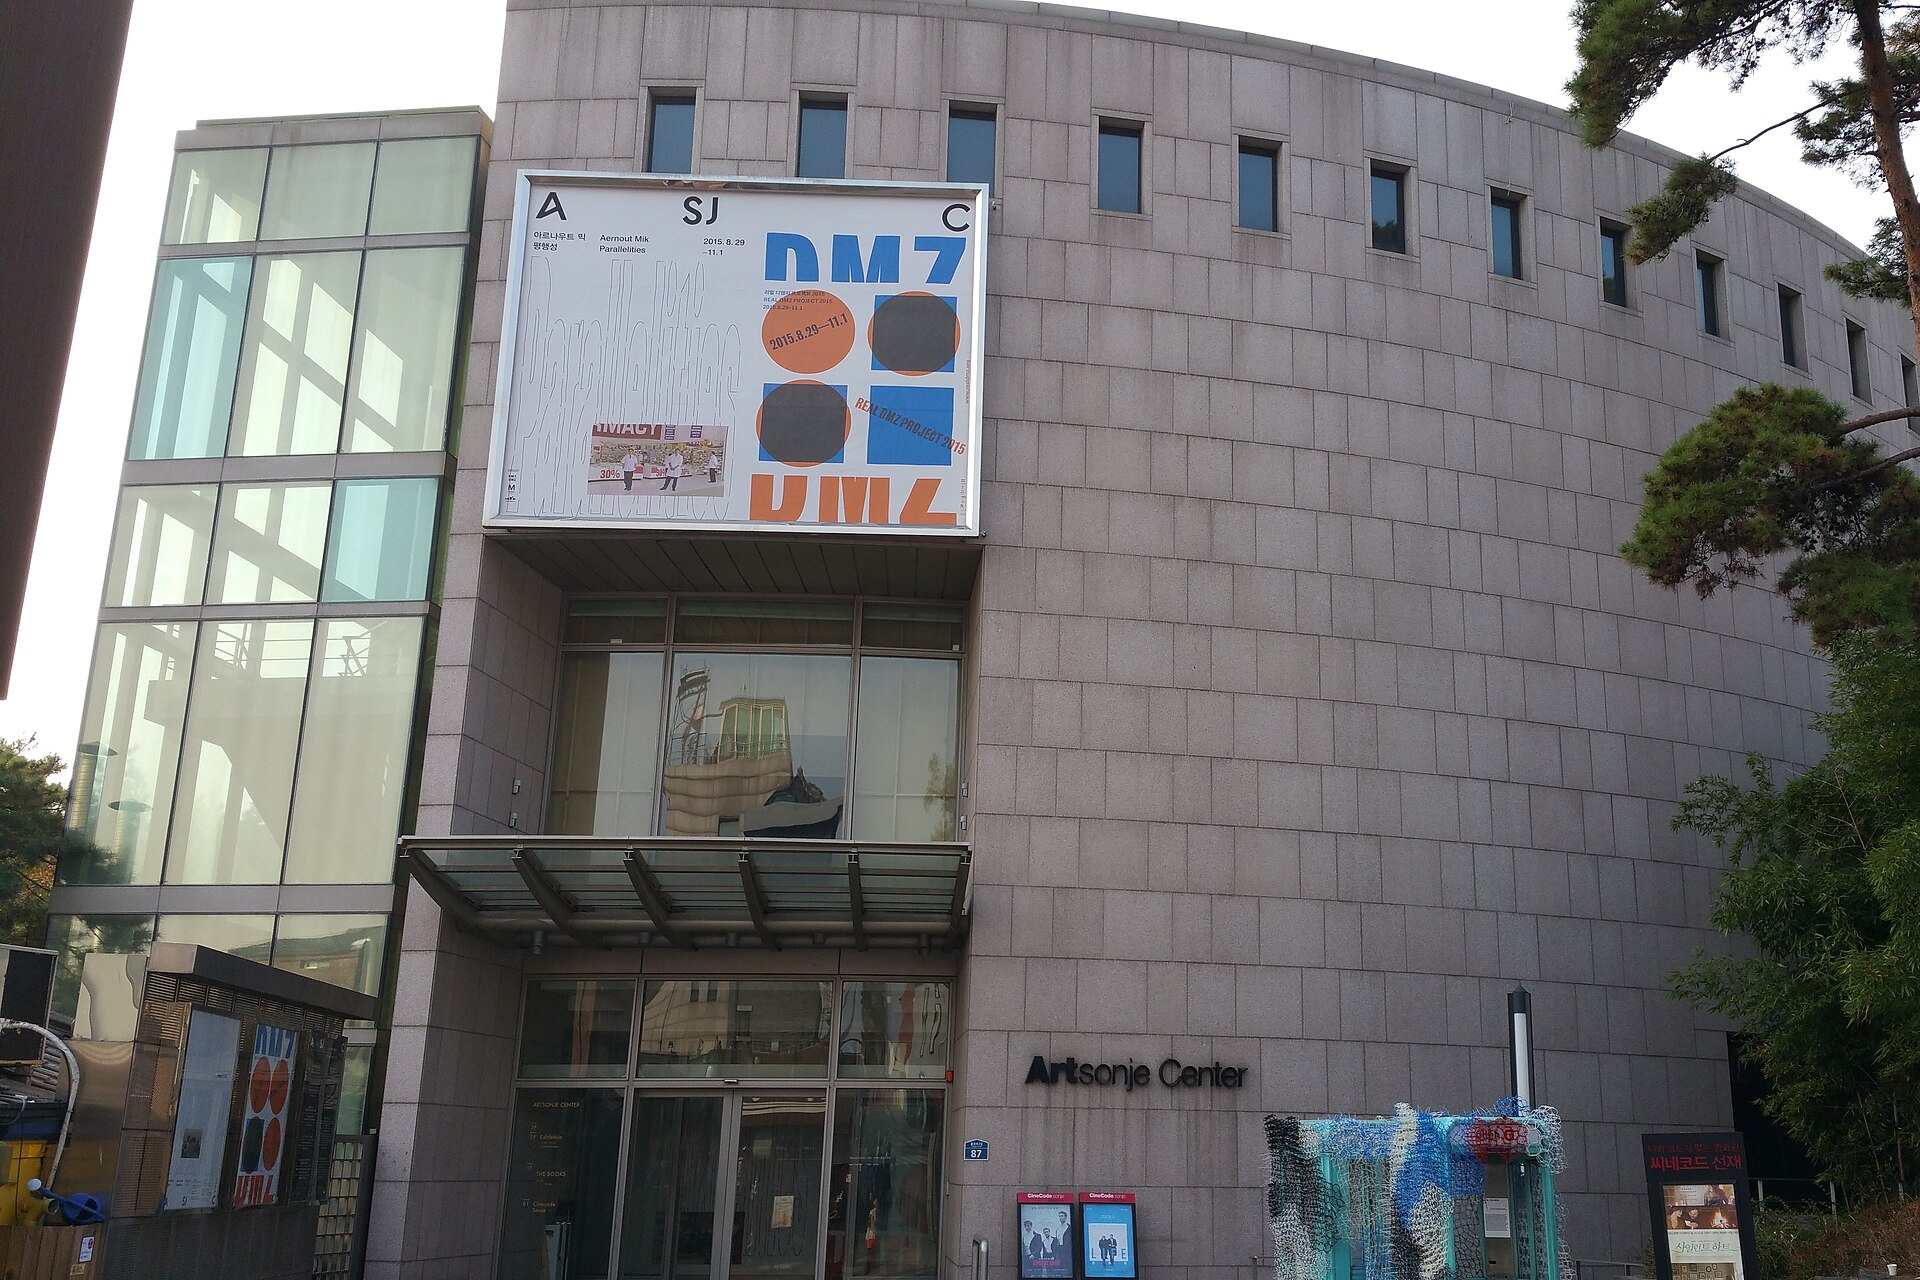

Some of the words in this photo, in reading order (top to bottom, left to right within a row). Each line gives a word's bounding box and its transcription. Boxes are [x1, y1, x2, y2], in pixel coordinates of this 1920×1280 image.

[535, 191, 568, 221] A
[941, 203, 971, 232] C
[533, 231, 575, 241] 아르나우트
[600, 234, 632, 244] Aernout
[634, 235, 650, 244] Mik
[533, 242, 558, 252] 평행성
[599, 245, 647, 254] Parallelities
[854, 397, 879, 417] REAL
[878, 407, 902, 426] DMZ
[900, 417, 943, 444] PROJECT
[941, 436, 967, 455] 2015
[600, 470, 620, 479] 30%
[1024, 1055, 1151, 1091] Artsonje
[1158, 1058, 1249, 1088] Center
[970, 1149, 982, 1158] 87
[1650, 1156, 1710, 1172] 씨네코드
[1712, 1154, 1743, 1170] 선재
